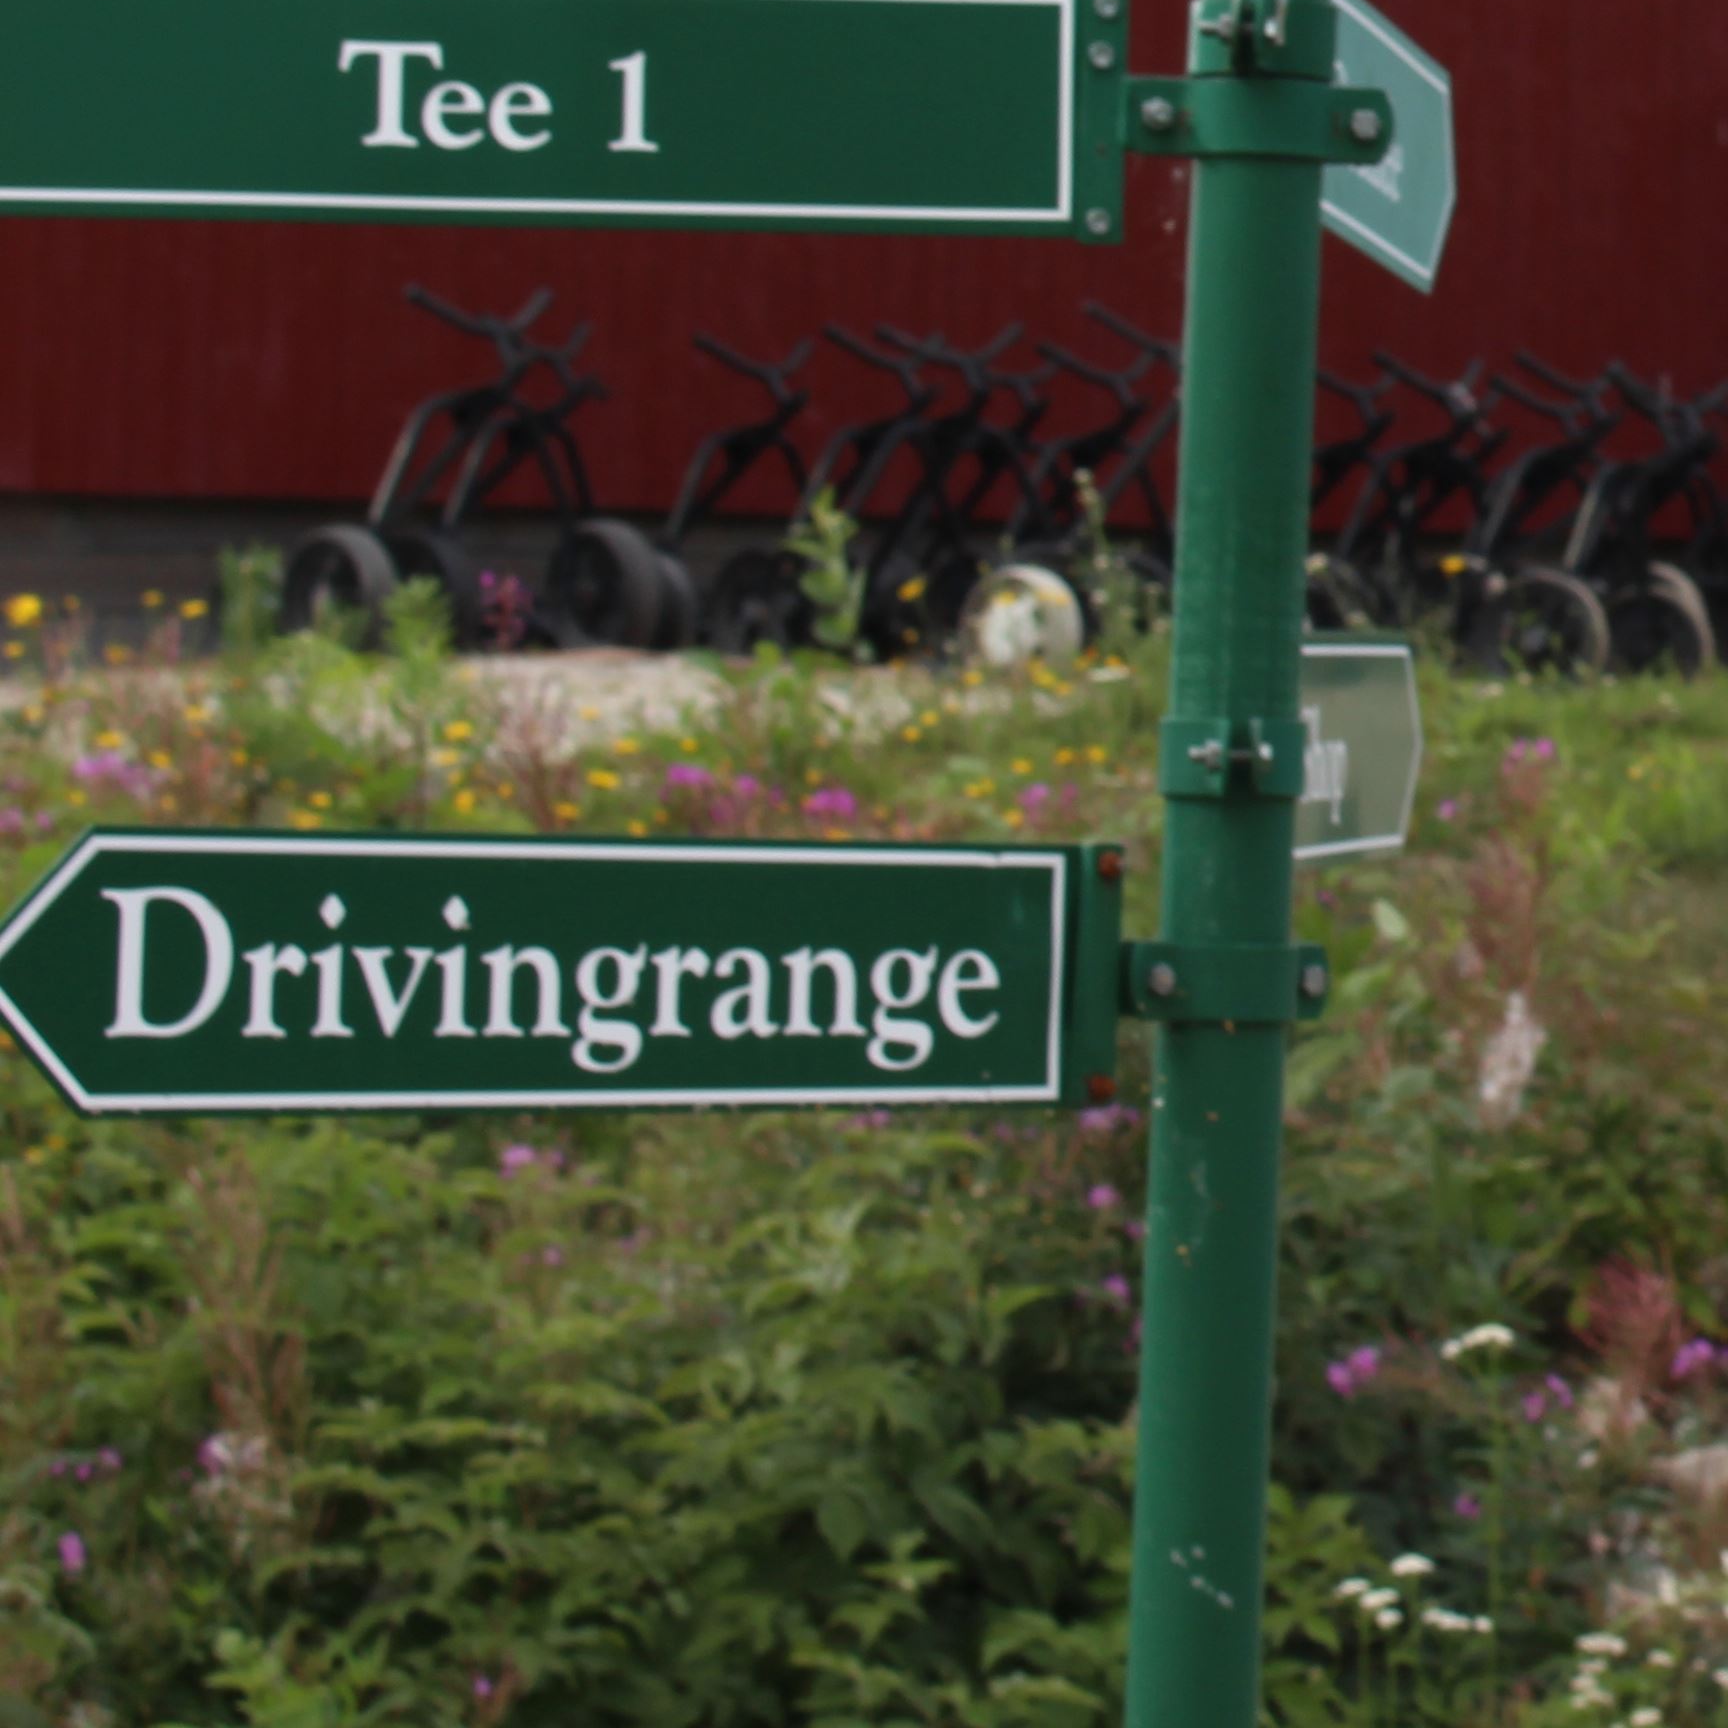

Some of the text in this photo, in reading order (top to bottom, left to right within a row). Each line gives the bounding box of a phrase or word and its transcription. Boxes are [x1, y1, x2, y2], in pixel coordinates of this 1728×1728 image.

[338, 39, 660, 153] Tee 1
[101, 886, 1000, 1073] Drivingrange
